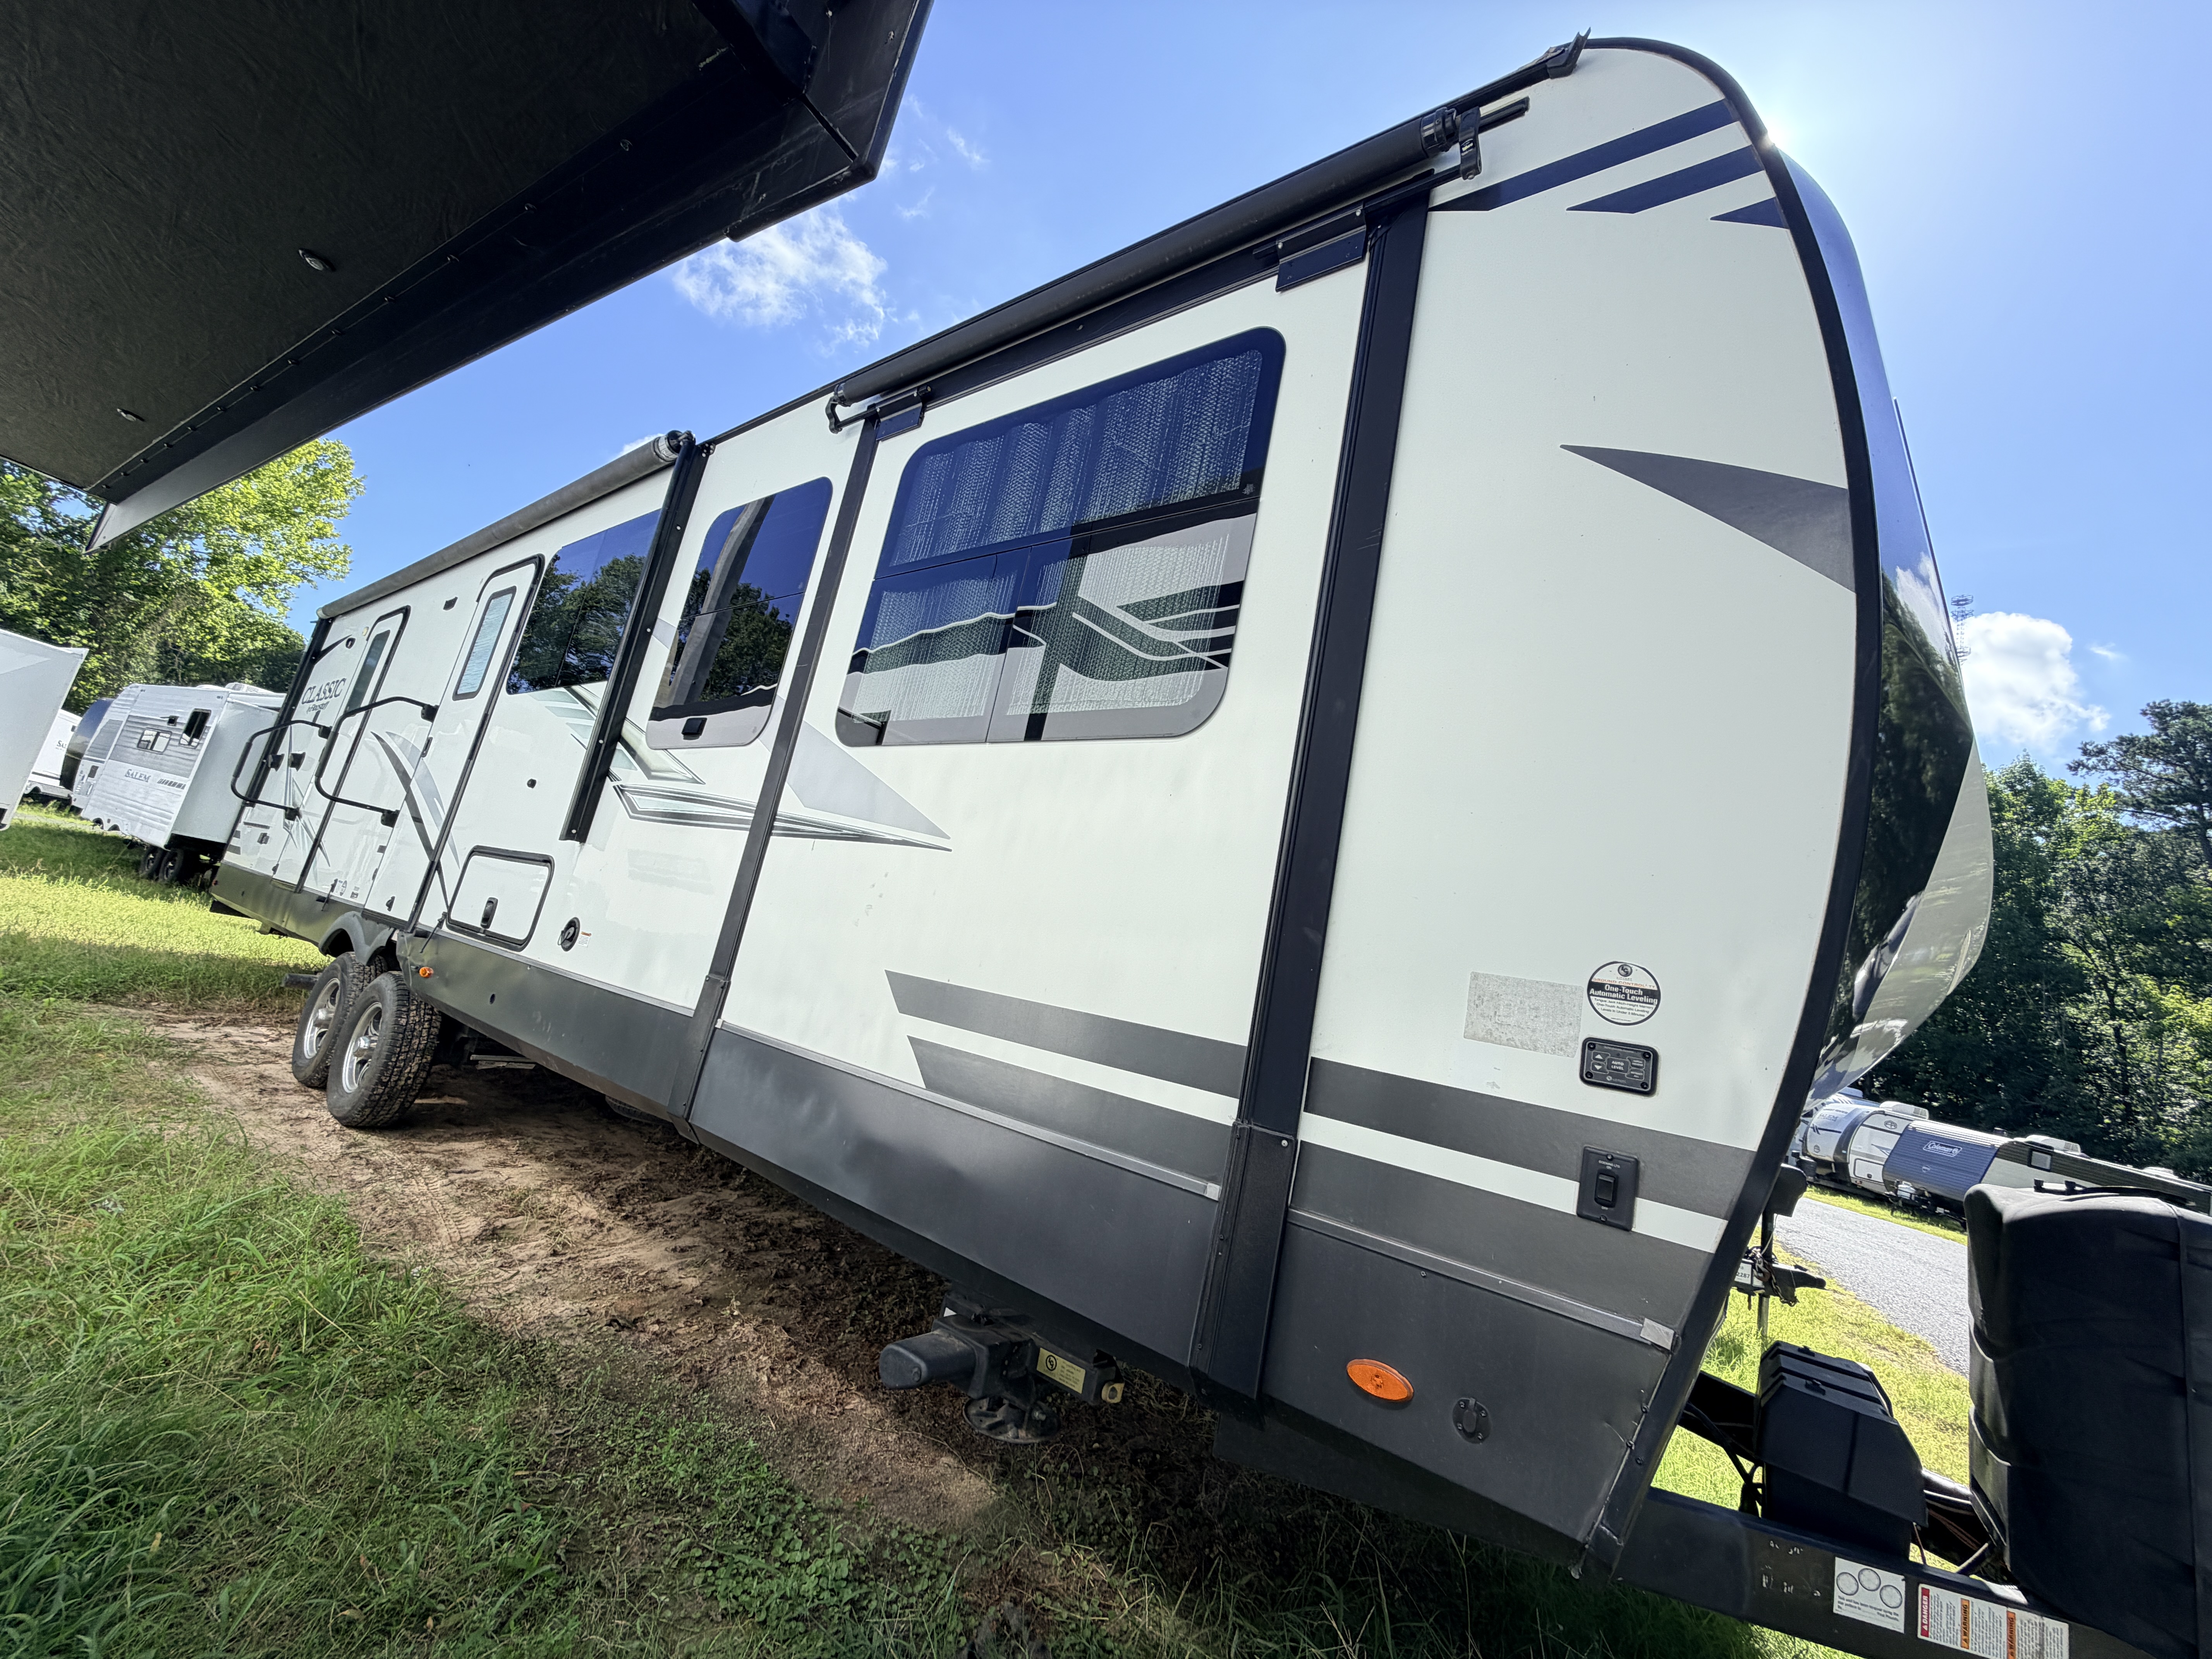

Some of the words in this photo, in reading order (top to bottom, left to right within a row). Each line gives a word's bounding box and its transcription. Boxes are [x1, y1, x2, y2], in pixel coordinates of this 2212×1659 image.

[302, 678, 347, 704] CLASSIC
[124, 769, 151, 783] SALEM
[1589, 988, 1626, 1000] Automatic
[1627, 993, 1658, 1006] Leveling
[1604, 984, 1643, 996] One-Touch
[1928, 1142, 1953, 1153] Coleman
